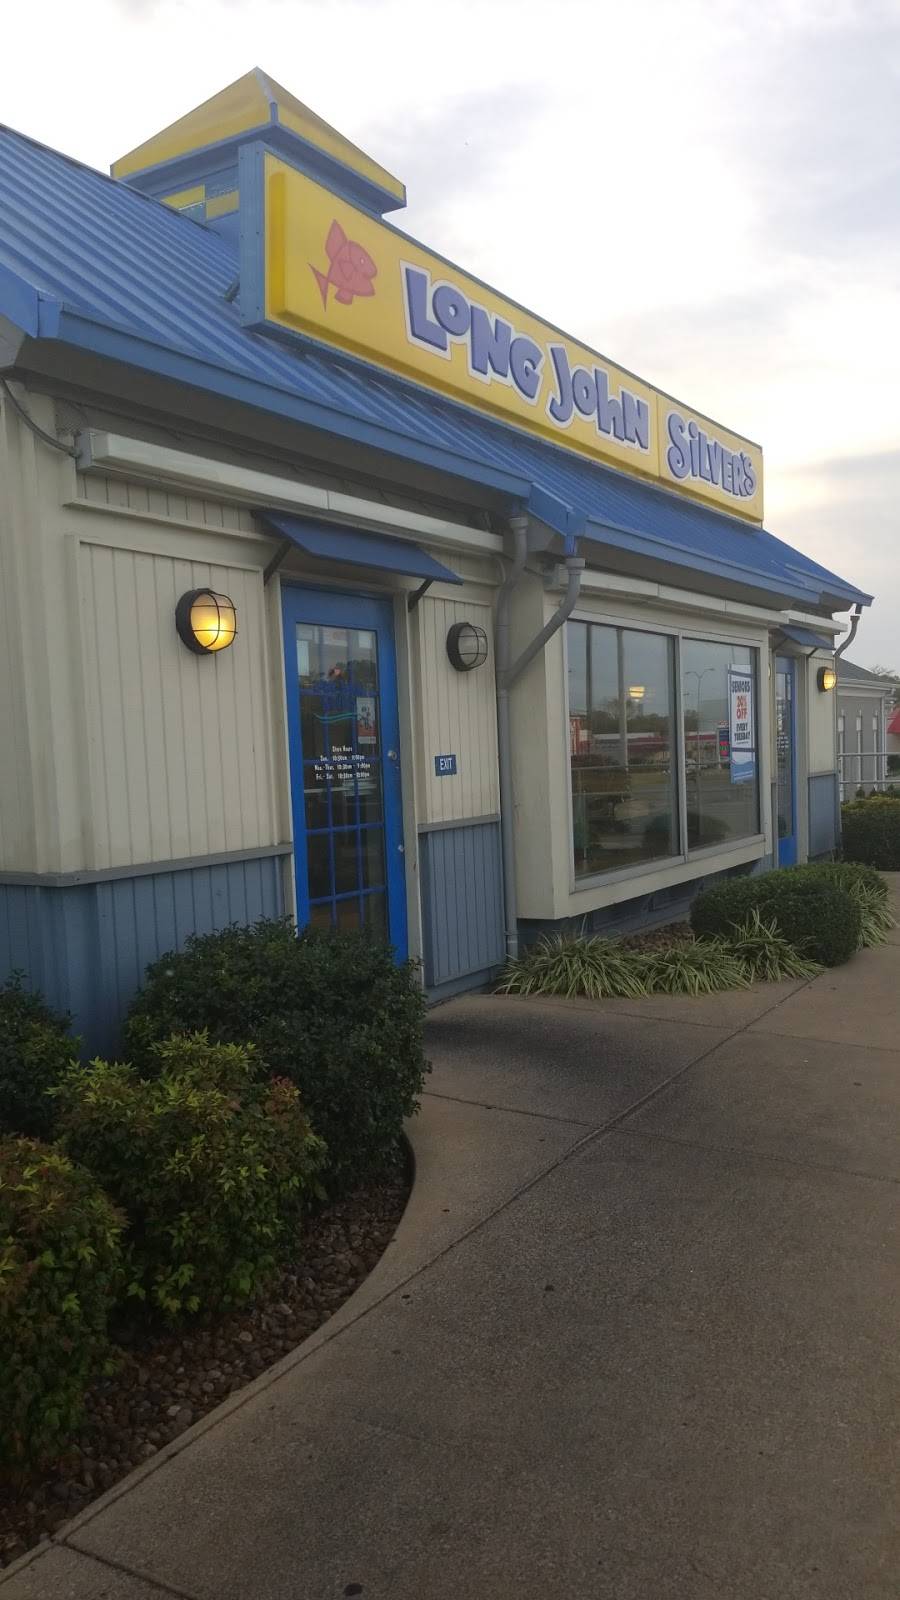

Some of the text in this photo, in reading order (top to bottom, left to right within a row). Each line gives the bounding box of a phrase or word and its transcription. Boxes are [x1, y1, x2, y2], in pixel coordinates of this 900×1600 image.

[404, 265, 544, 401] LONG
[732, 681, 750, 693] SENIORS
[736, 708, 748, 719] OFF
[736, 722, 748, 732] EVERY
[734, 731, 750, 742] TUESDAY
[439, 757, 453, 771] EXIT
